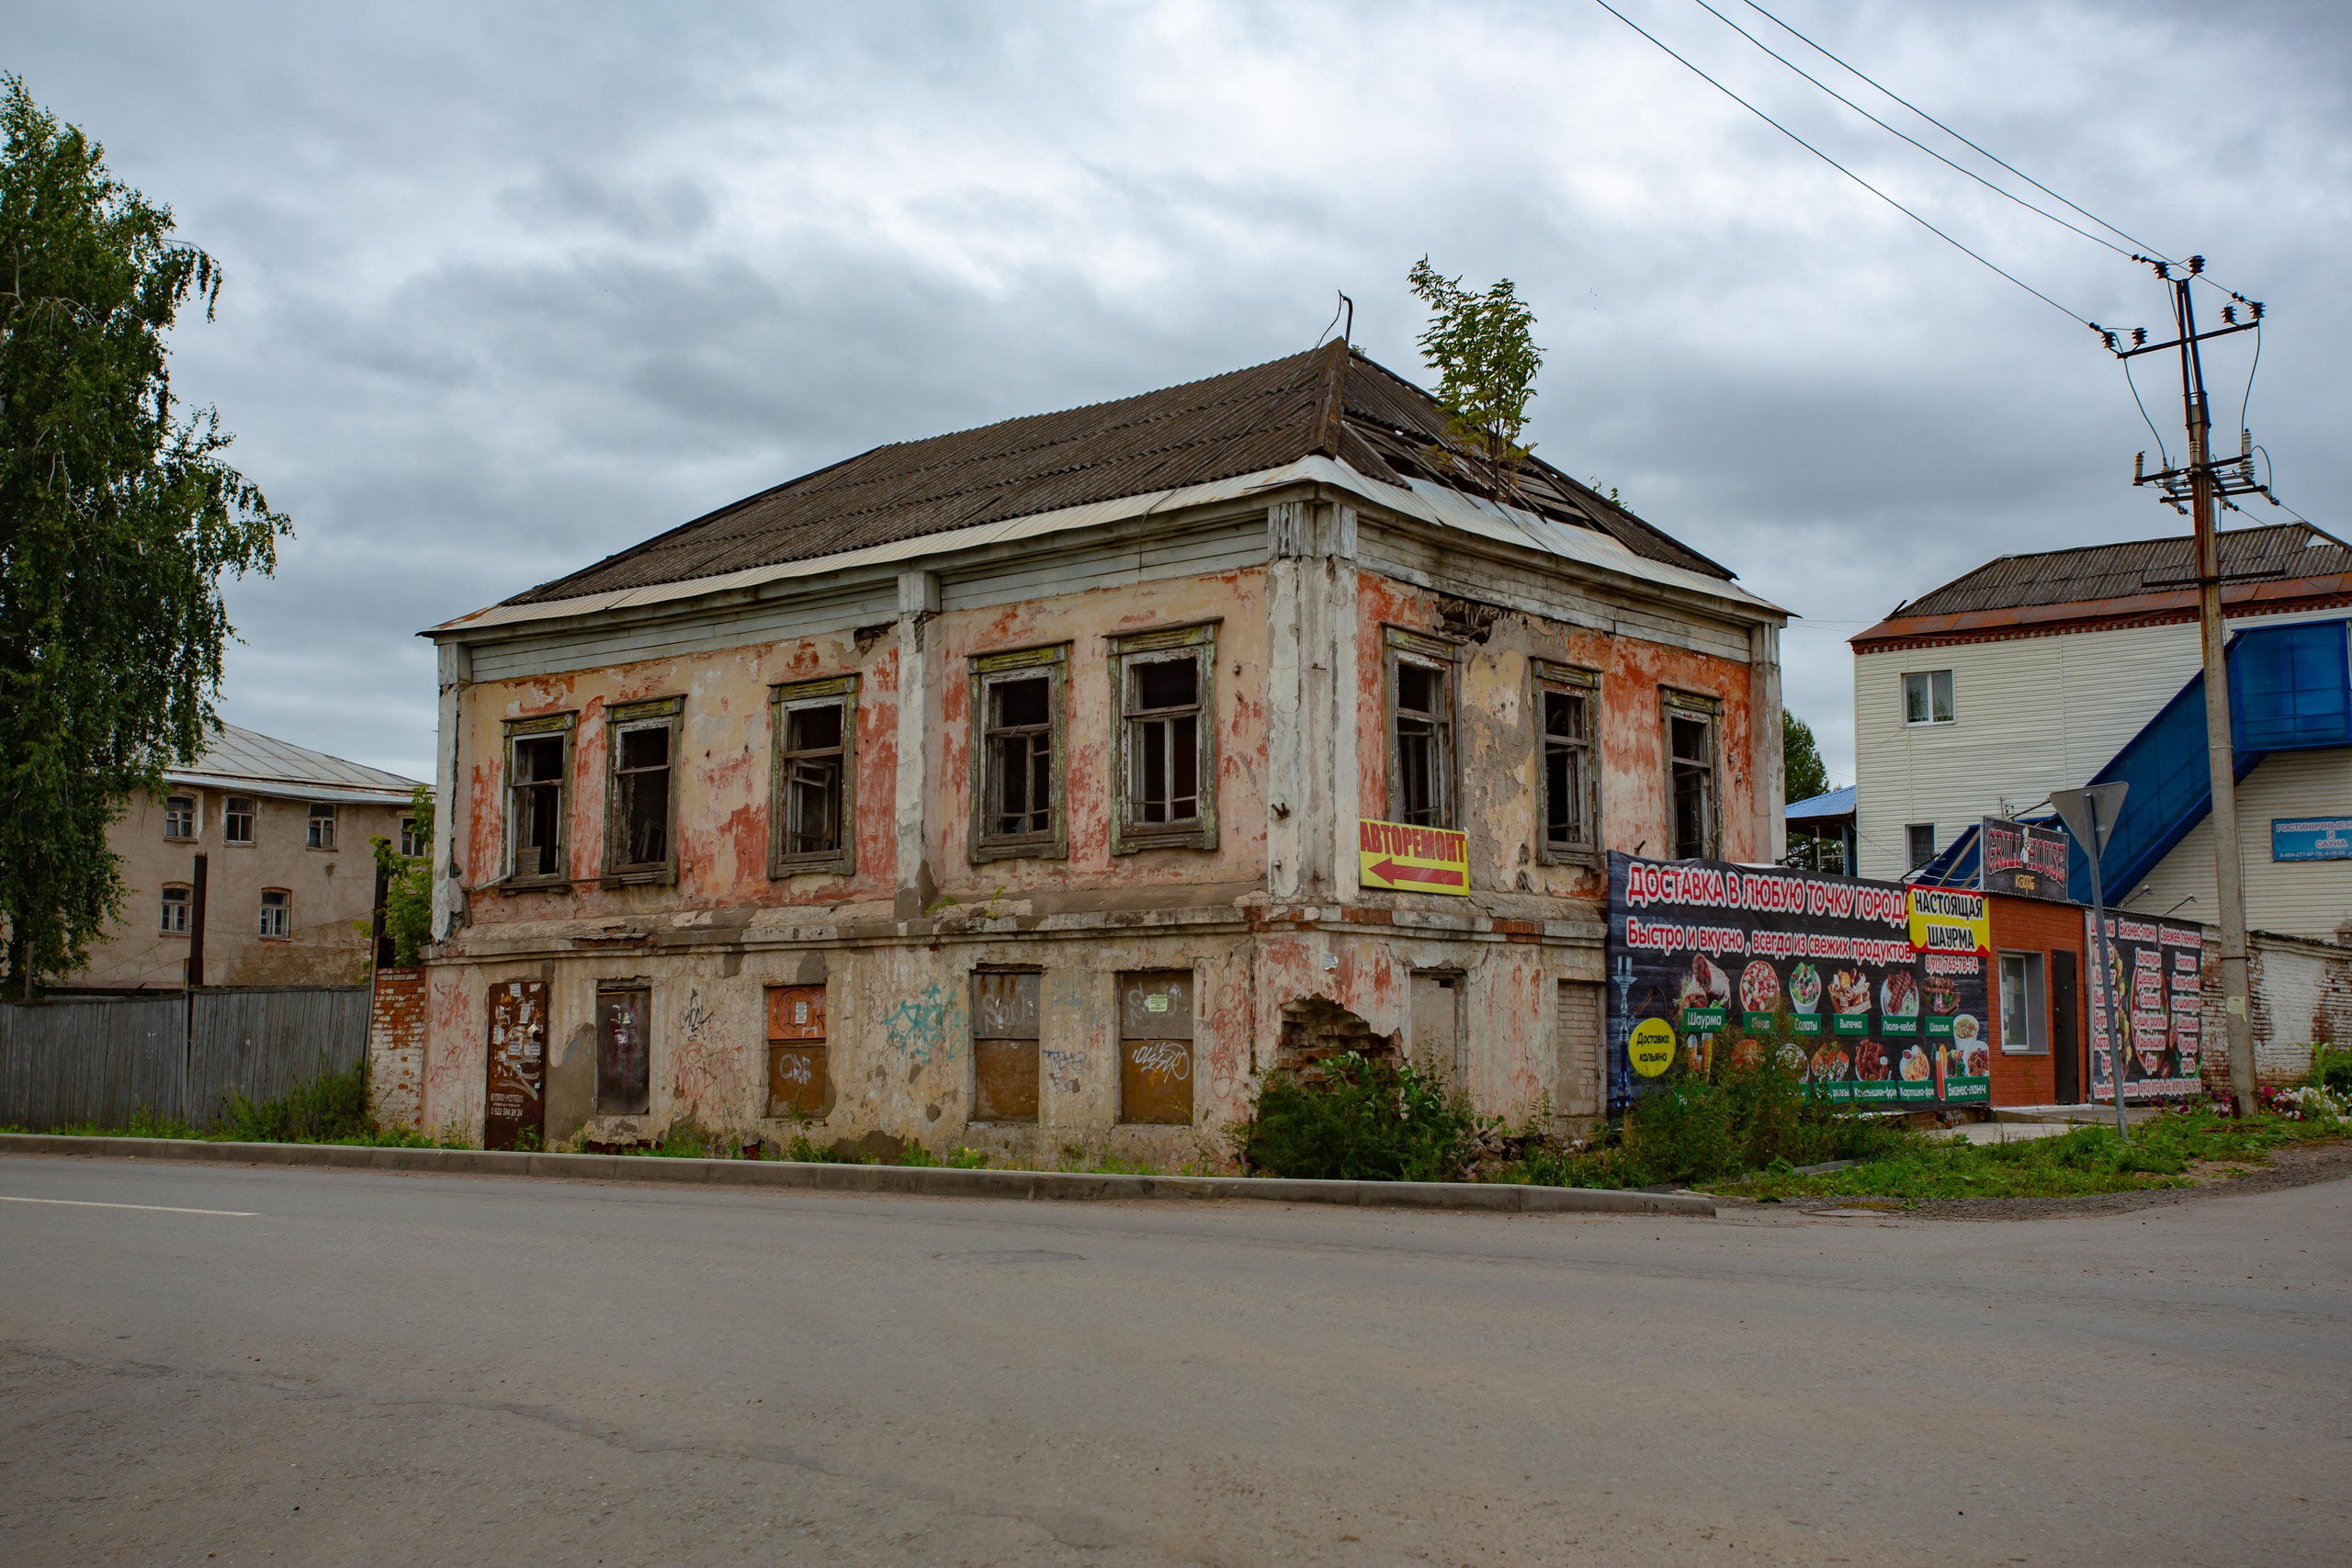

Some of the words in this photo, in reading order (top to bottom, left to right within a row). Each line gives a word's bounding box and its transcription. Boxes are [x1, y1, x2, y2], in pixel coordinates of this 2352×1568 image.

[2277, 822, 2344, 832] ГОСТИНИЧНЫЕ
[2327, 830, 2335, 839] И
[1360, 821, 1465, 863] АВТОРЕМОНТ
[2315, 840, 2347, 848] САУНА
[1987, 828, 2022, 875] GRILL
[2027, 837, 2065, 888] HOUSE
[1627, 862, 1726, 908] ДОСТАВКА
[1726, 872, 1741, 908] В
[1742, 874, 1805, 914] ЛЮБУЮ
[1806, 880, 1854, 919] ТОЧКУ
[1912, 889, 1984, 922] НАСТОЯЩАЯ
[1626, 916, 1685, 956] Быстро
[1686, 925, 1697, 951] и
[1752, 930, 1792, 960] всегда
[1793, 933, 1806, 956] из
[1807, 933, 1849, 958] свежих
[1927, 924, 1975, 951] ШАУРМА
[1943, 956, 1979, 974] 765-78-74
[2135, 947, 2161, 971] Хачапури
[2176, 952, 2197, 971] Напитки
[2137, 968, 2161, 989] Десерты
[2140, 990, 2160, 1009] Салаты
[1688, 1012, 1722, 1030] Шаурма
[1794, 1019, 1818, 1031] Салаты
[1839, 1019, 1862, 1030] Выпечка
[1883, 1021, 1917, 1032] Люля-кебаб
[1929, 1021, 1950, 1032] Шашлык
[1636, 1032, 1669, 1045] Доставка
[2135, 1030, 2165, 1054] Крылышки
[1639, 1051, 1668, 1063] кальяна
[2145, 1053, 2157, 1075] фри
[1899, 1087, 1934, 1100] Картошка-фри
[1948, 1083, 1986, 1097] Бизнес-ланч
